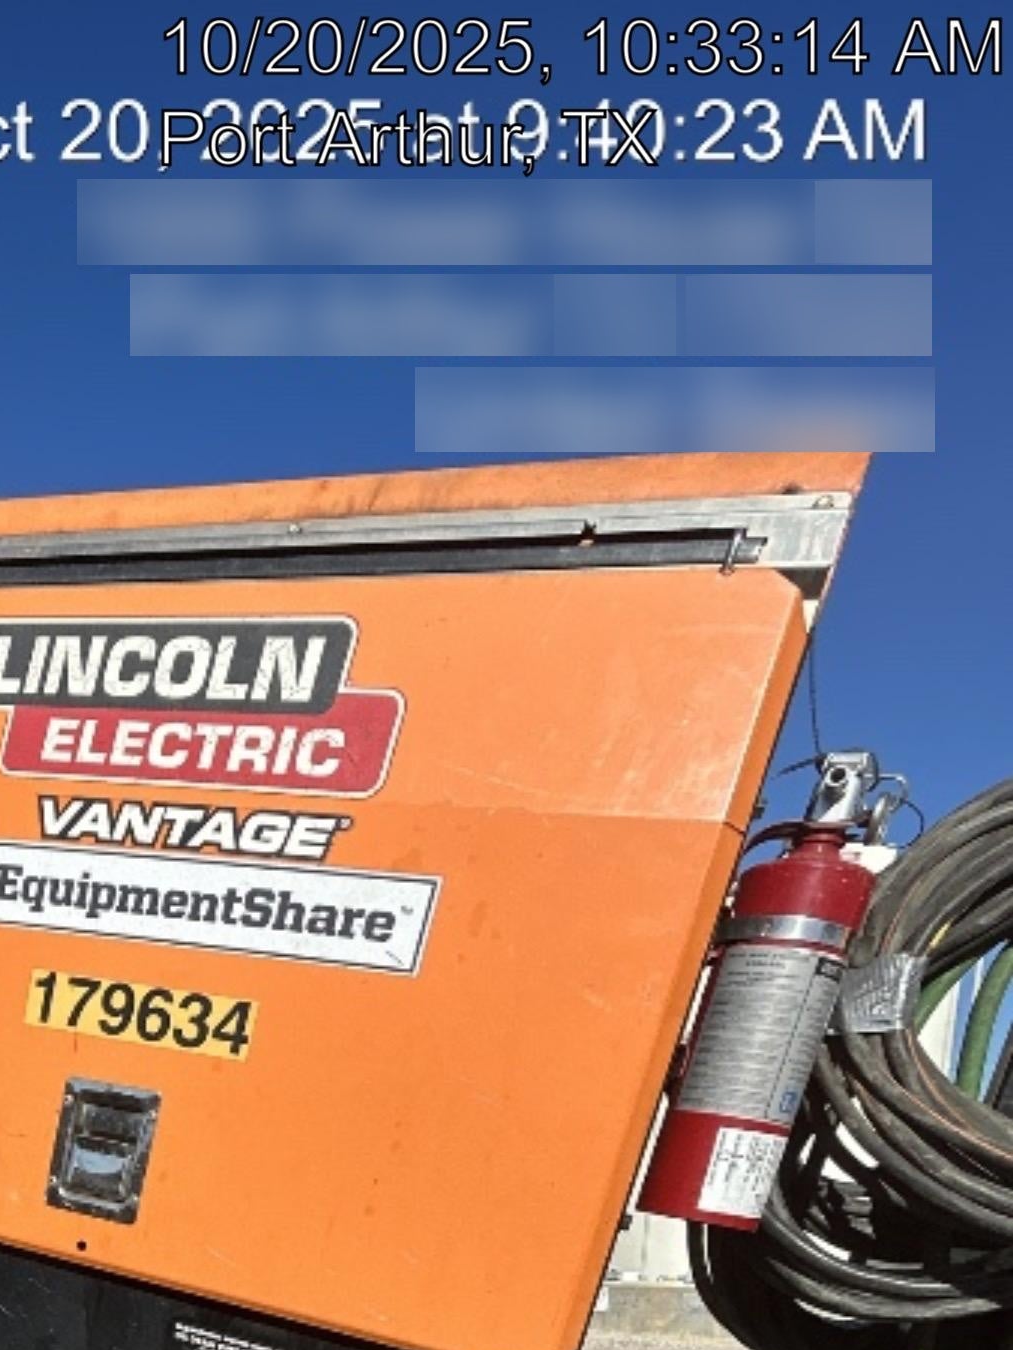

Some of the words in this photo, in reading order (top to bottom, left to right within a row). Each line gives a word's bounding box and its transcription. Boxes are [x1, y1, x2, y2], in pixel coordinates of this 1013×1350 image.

[40, 717, 345, 776] ELECTRIC
[38, 795, 337, 859] VANTAGE
[34, 970, 252, 1055] 179634
